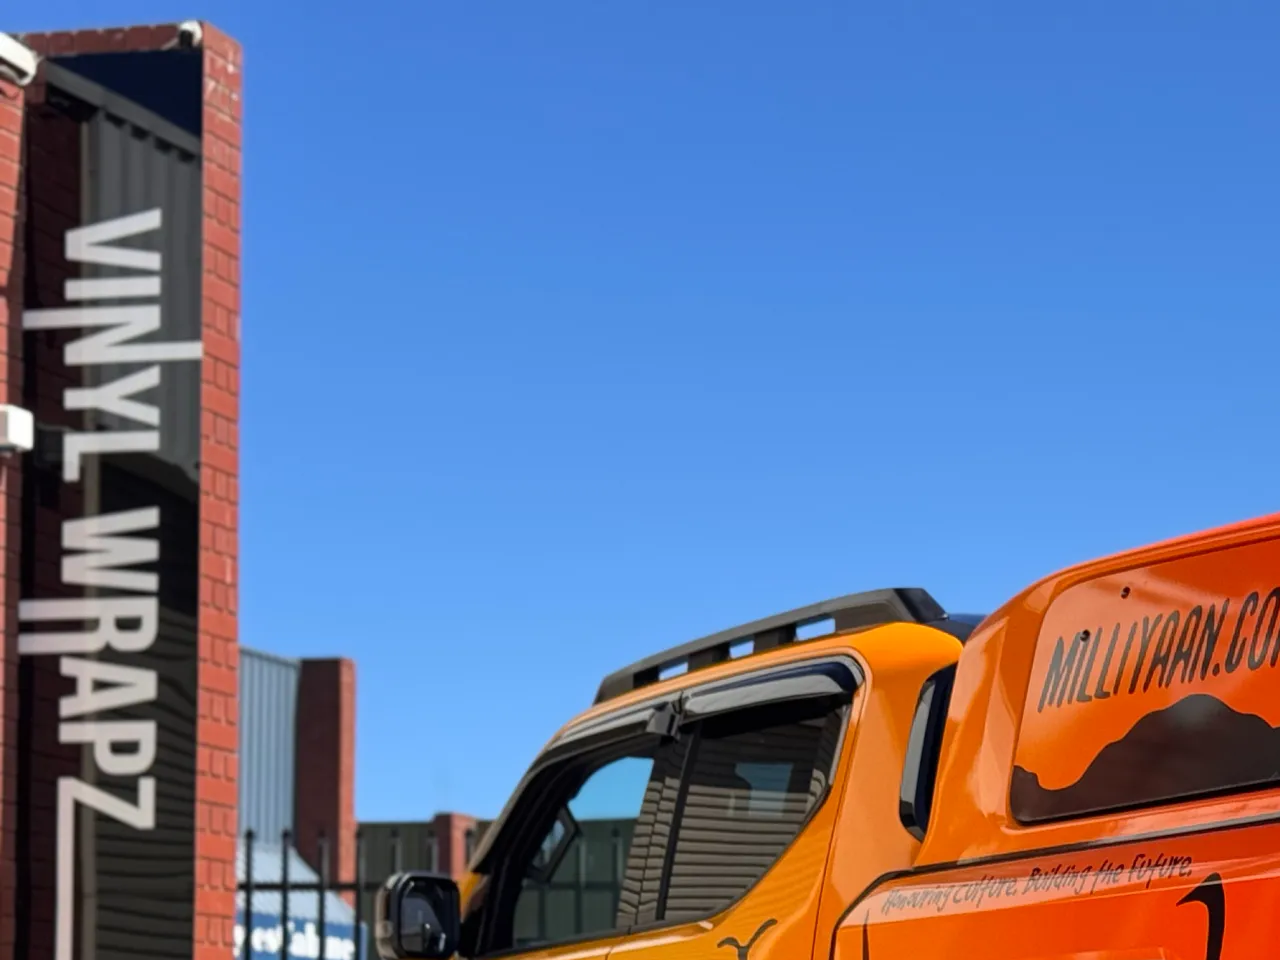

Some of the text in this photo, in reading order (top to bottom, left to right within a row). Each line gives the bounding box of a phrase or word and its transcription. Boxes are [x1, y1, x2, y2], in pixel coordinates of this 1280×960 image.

[22, 207, 204, 483] VINYL
[1021, 863, 1092, 896] Building
[1090, 859, 1124, 894] the
